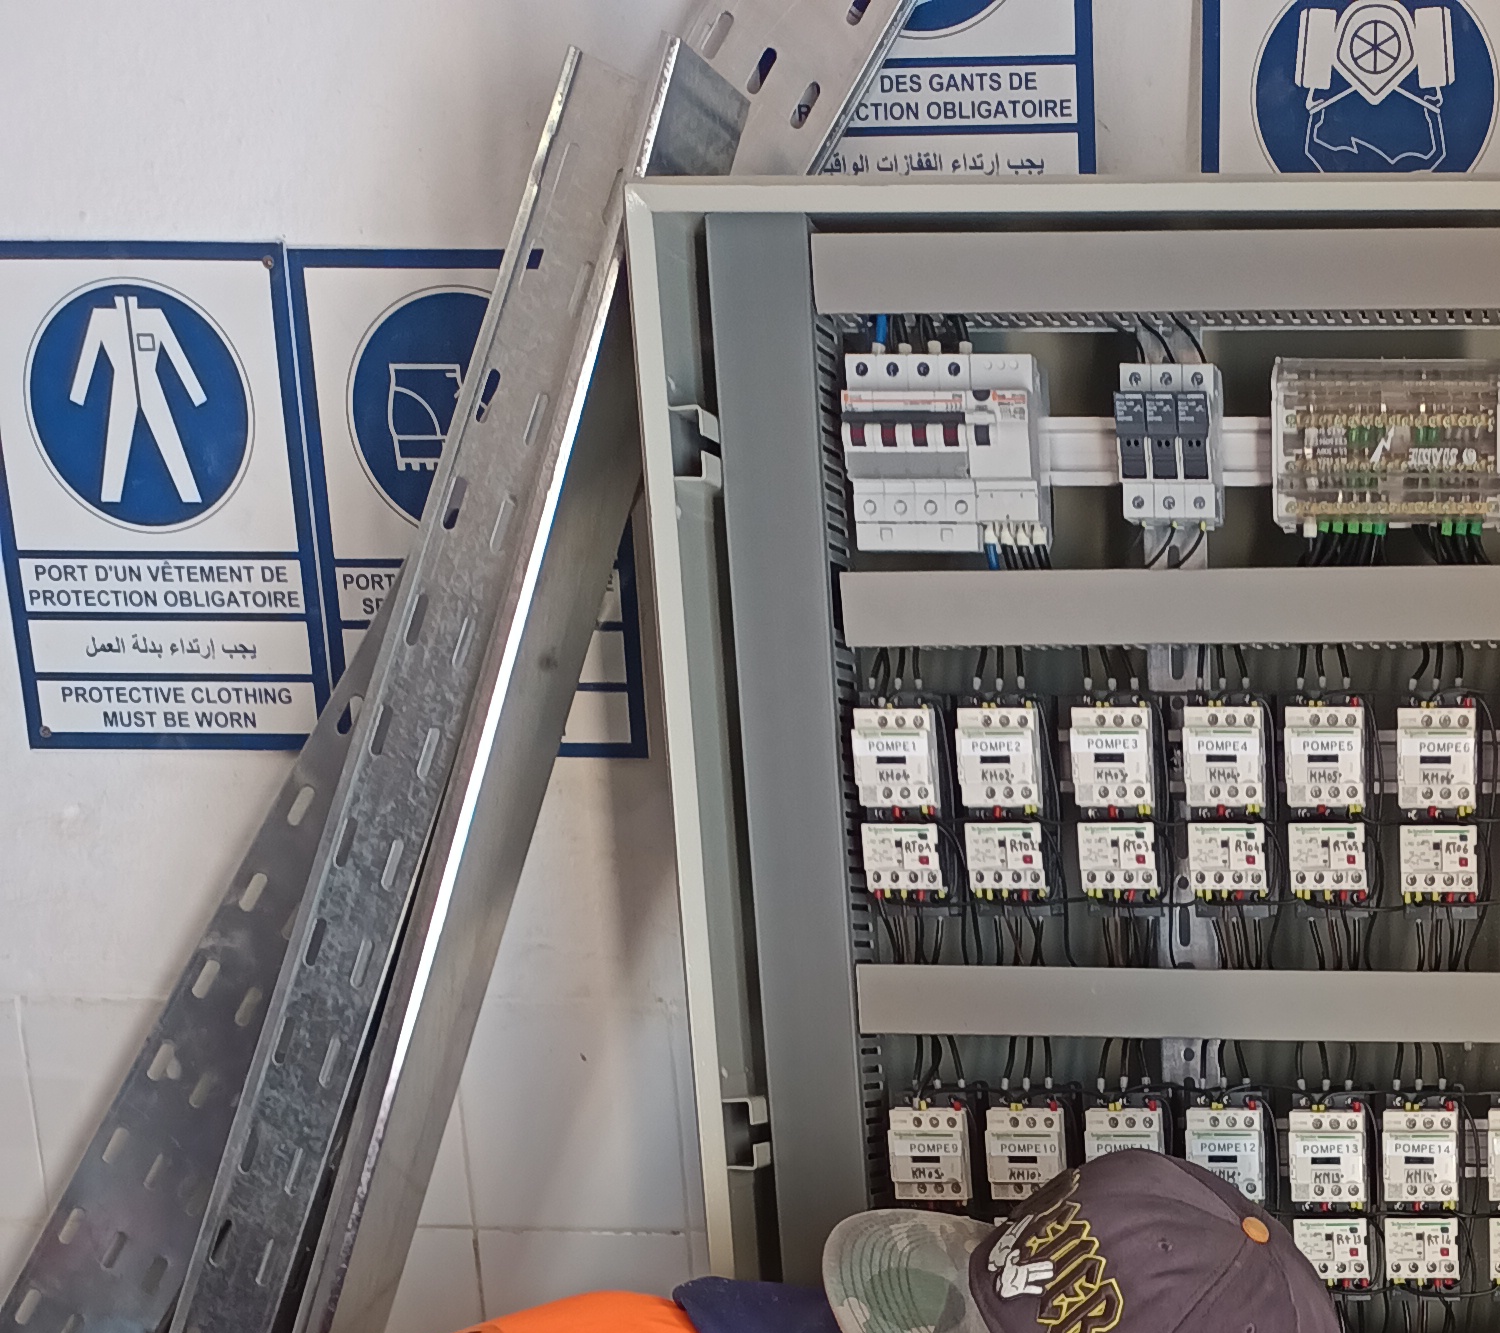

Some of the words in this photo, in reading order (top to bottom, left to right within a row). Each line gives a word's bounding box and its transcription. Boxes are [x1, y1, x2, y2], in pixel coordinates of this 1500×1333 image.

[880, 74, 922, 93] DES
[928, 73, 1002, 92] GANTS
[1009, 72, 1037, 91] DE
[926, 99, 1073, 120] OBLIGATOIRE
[1006, 157, 1045, 175] يجب
[34, 564, 88, 582] PORT
[95, 565, 142, 582] D'UN
[148, 560, 255, 583] VÊTEMENT
[261, 566, 288, 583] DE
[342, 573, 396, 591] PORT
[29, 589, 157, 607] PROTECTION
[163, 590, 301, 608] OBLIGATOIRE
[86, 636, 126, 658] العمل
[222, 641, 257, 660] يجب
[61, 686, 186, 704] PROTECTIVE
[191, 687, 293, 705] CLOTHING
[103, 711, 157, 728] MUST
[163, 711, 190, 728] BE
[195, 711, 257, 728] WORN
